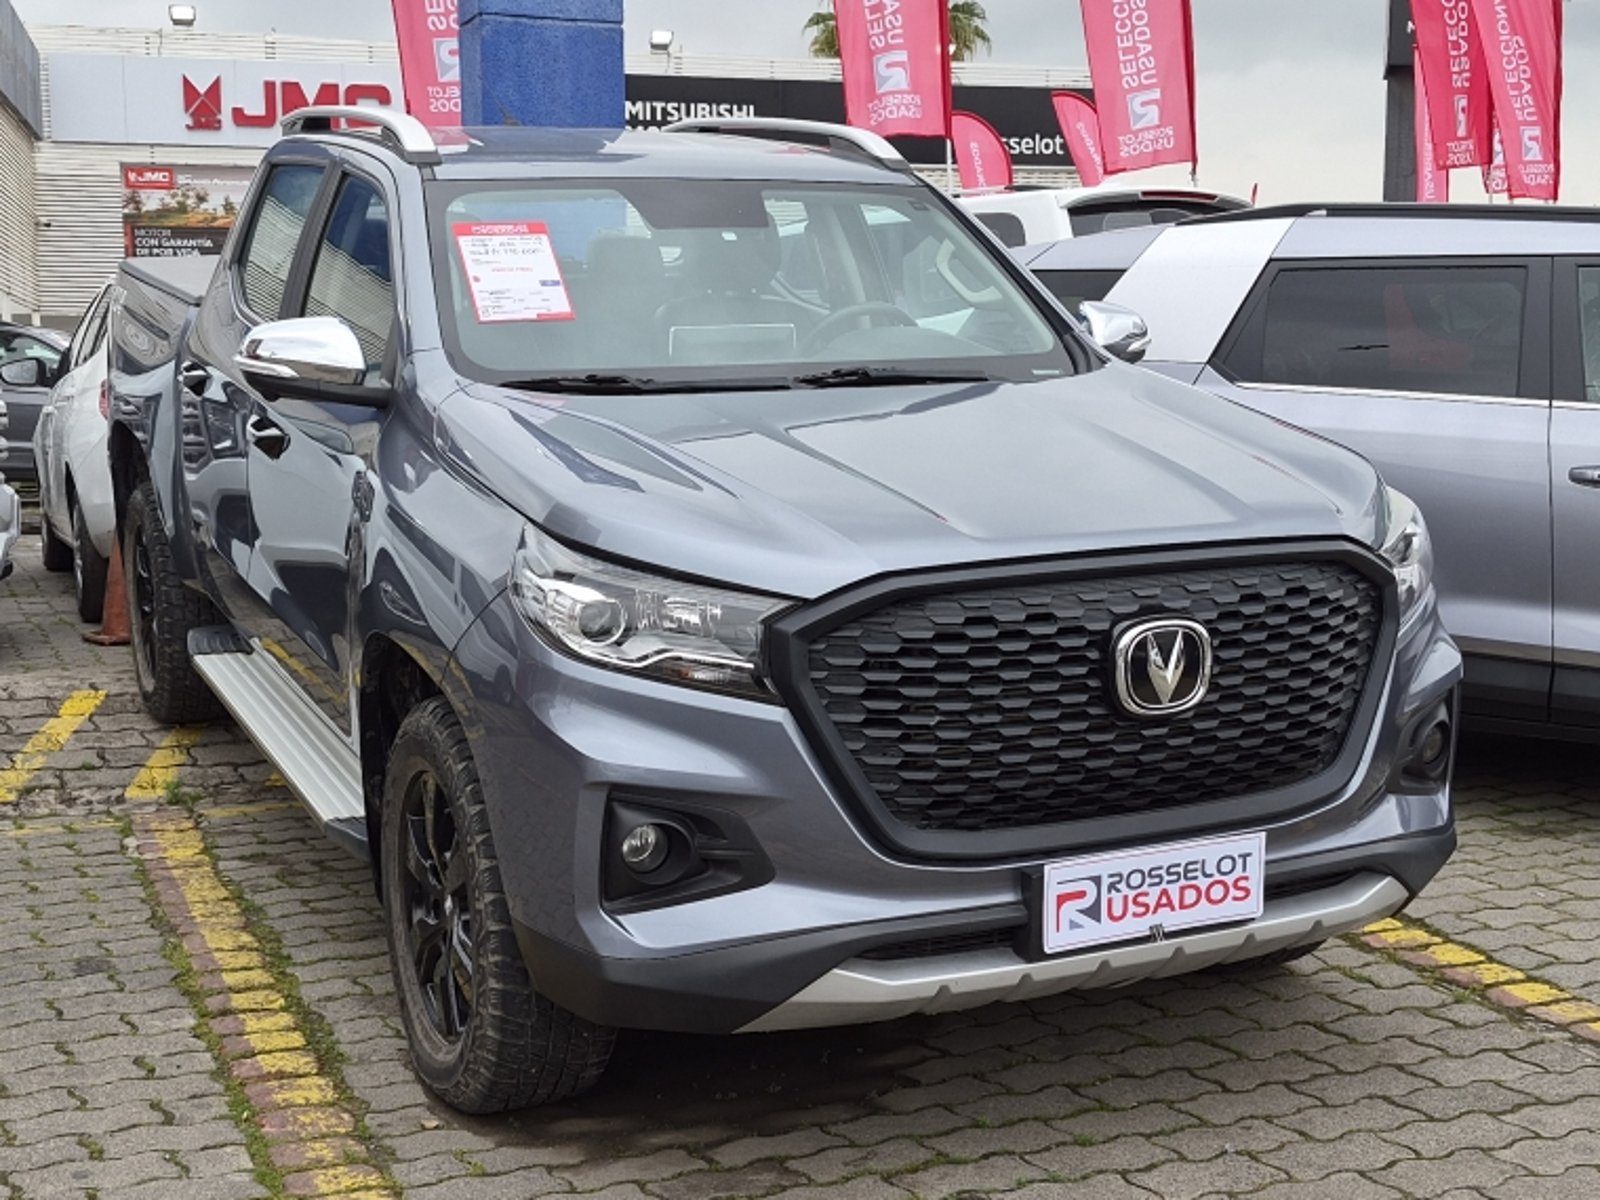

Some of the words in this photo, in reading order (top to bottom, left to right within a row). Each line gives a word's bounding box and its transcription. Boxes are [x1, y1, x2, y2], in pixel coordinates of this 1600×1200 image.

[232, 80, 391, 130] JMC
[624, 101, 755, 121] MITSUBISHI
[135, 238, 159, 247] CON
[1107, 853, 1253, 894] ROSSELOT
[1106, 875, 1252, 923] USADOS
